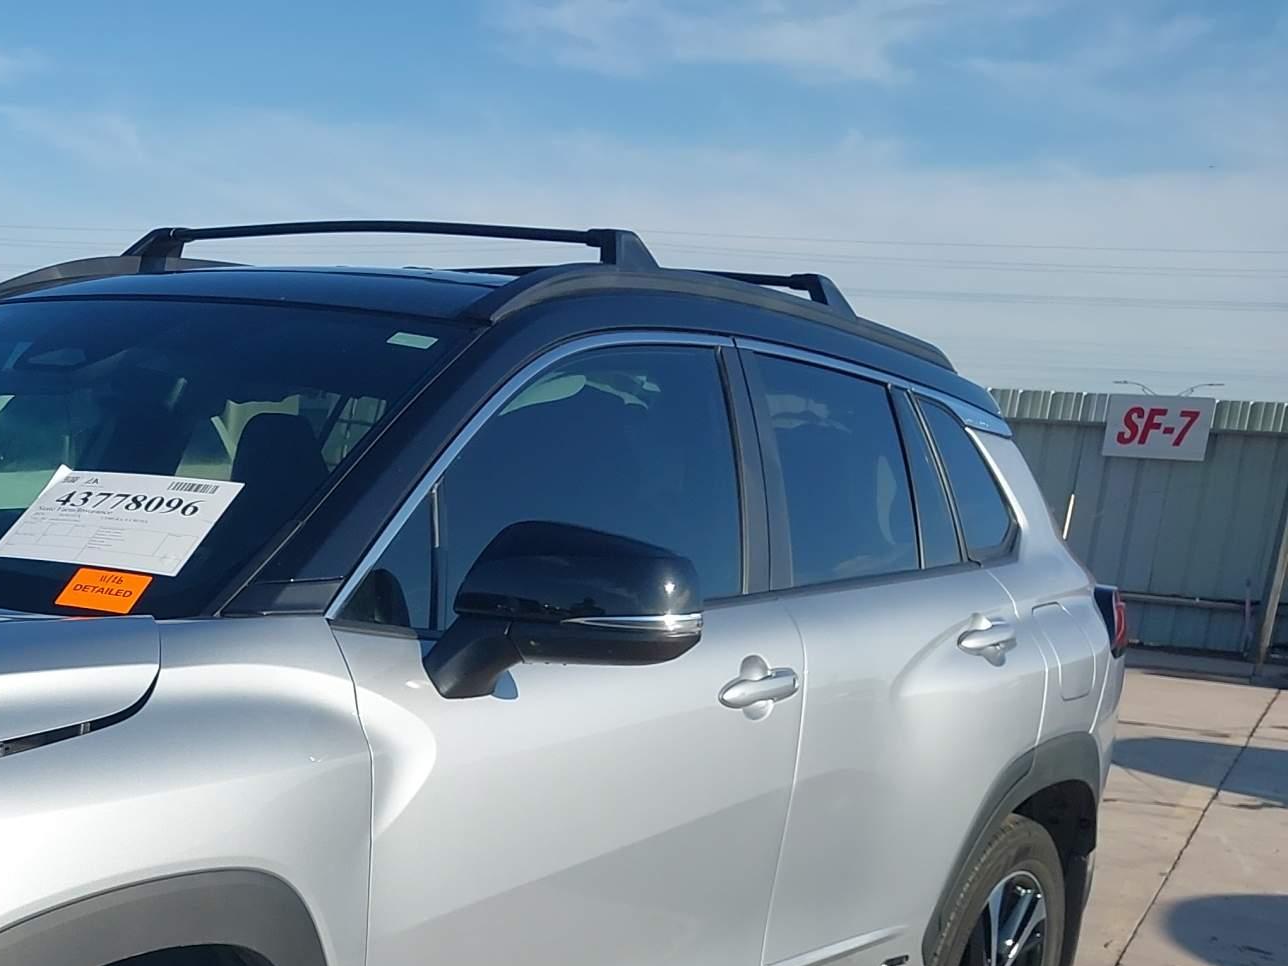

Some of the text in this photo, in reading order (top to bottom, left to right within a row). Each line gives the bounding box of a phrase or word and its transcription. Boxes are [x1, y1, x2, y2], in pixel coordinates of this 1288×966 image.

[1116, 406, 1201, 447] SF-7
[55, 490, 209, 517] 43778096
[73, 583, 133, 598] DETAILED
